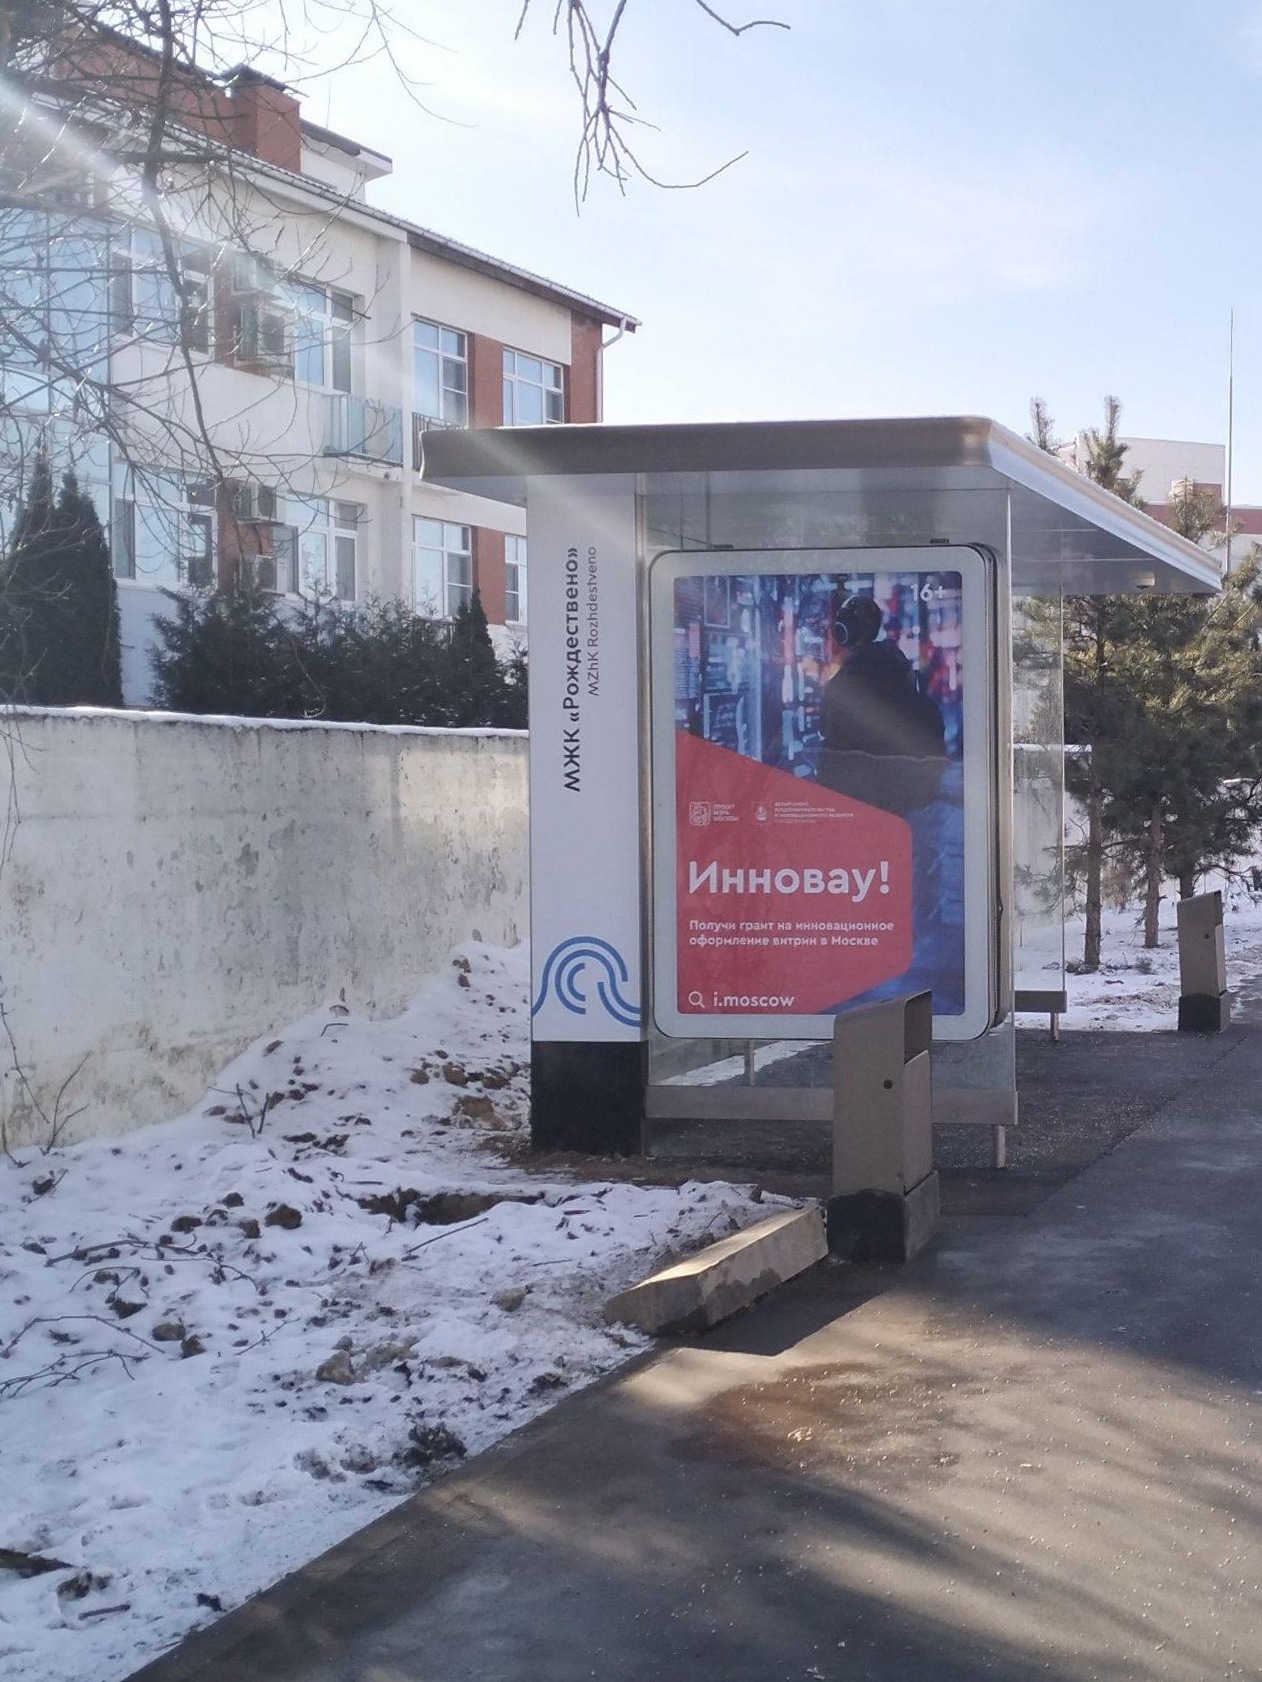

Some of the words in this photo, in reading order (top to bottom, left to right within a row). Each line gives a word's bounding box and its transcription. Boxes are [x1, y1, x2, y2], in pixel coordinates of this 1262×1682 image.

[587, 546, 599, 648] Rozhdestveno
[911, 583, 947, 601] 16+
[563, 547, 581, 722] «Рождествено»
[587, 651, 599, 696] MZhK
[563, 728, 580, 792] МЖК
[689, 861, 890, 902] Инновау!
[689, 920, 736, 932] Получи
[739, 922, 774, 932] грант
[777, 922, 792, 931] на
[795, 922, 895, 933] инновационное
[689, 935, 770, 947] оформление
[772, 936, 817, 947] витрин
[820, 937, 828, 946] в
[831, 935, 879, 946] Москве
[713, 991, 795, 1007] i.moscow
